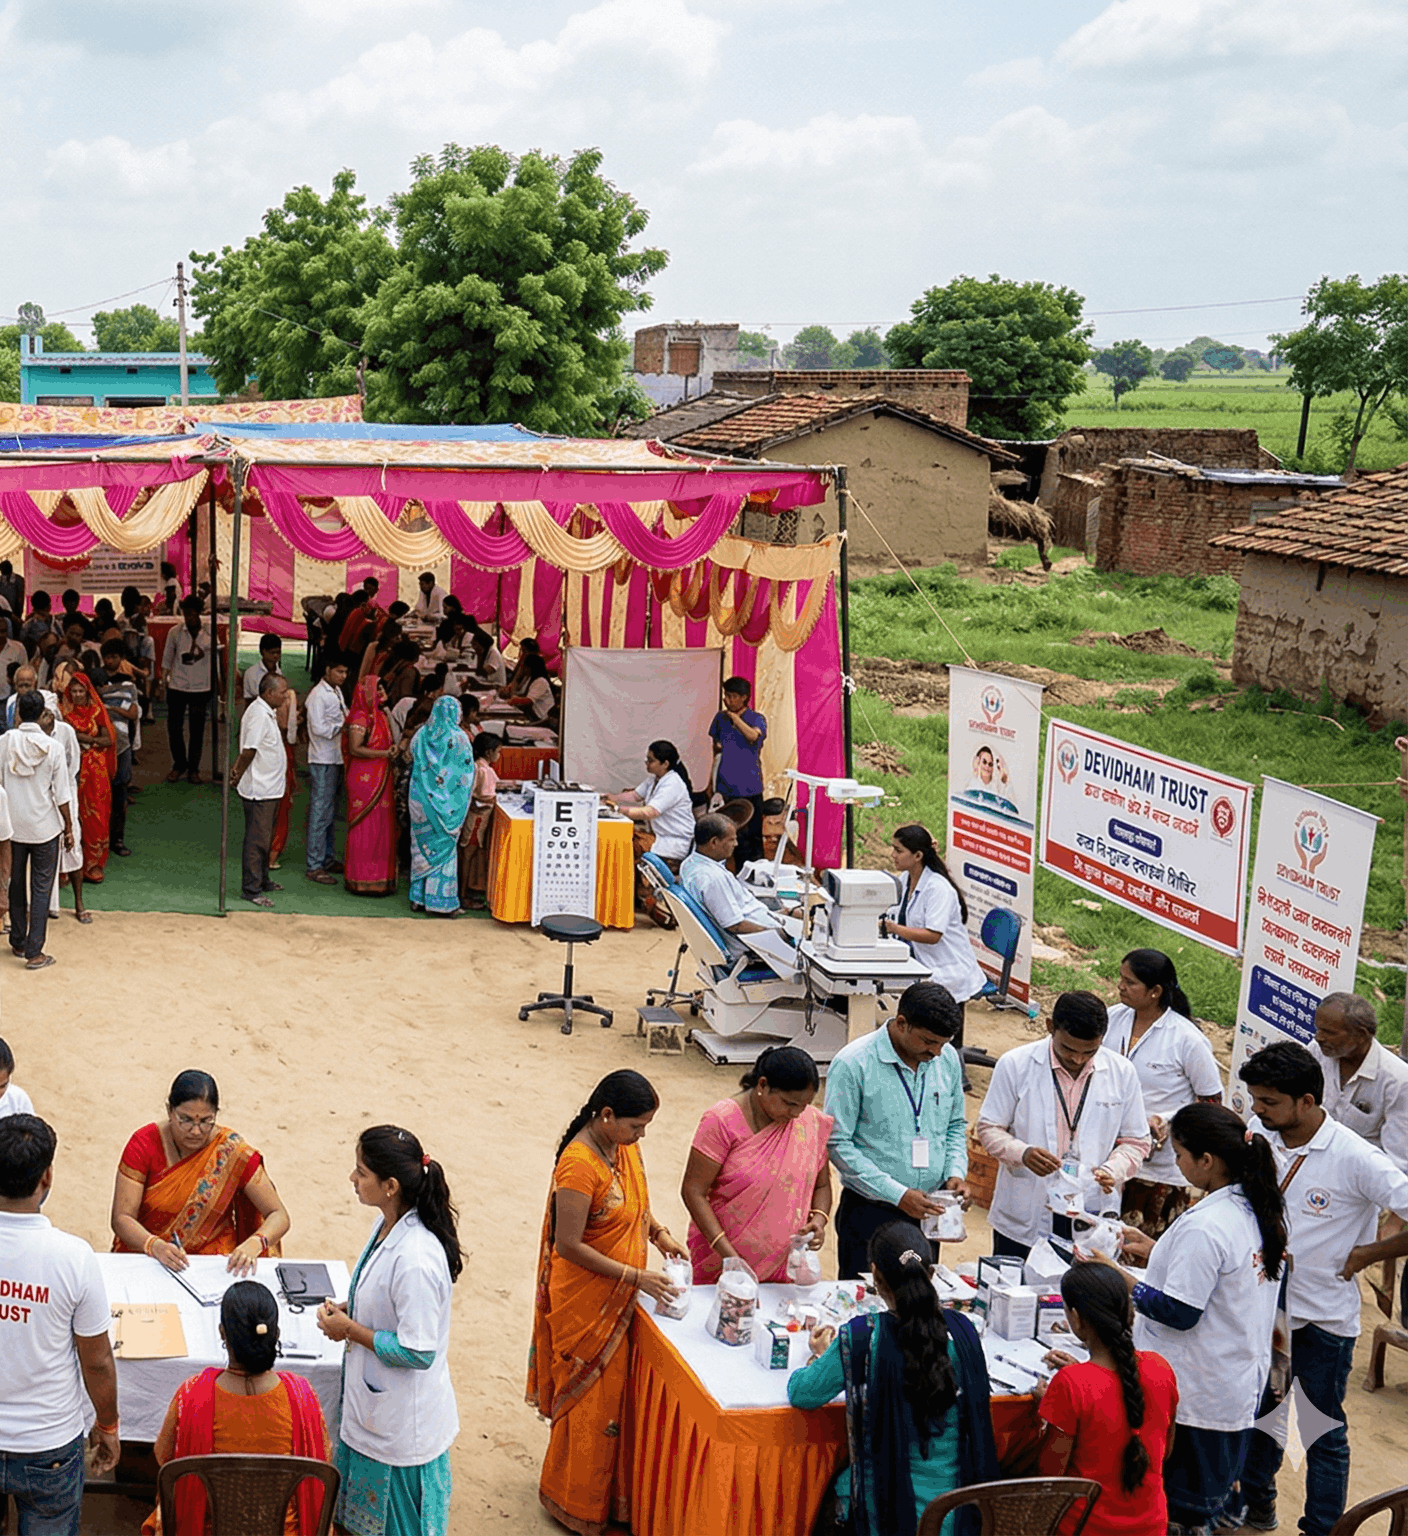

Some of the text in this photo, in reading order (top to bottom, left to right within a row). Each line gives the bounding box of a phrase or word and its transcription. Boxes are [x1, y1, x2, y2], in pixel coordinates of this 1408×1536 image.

[1084, 748, 1156, 795] DEVIDHAM
[1160, 775, 1208, 814] TRUST
[555, 802, 572, 822] E
